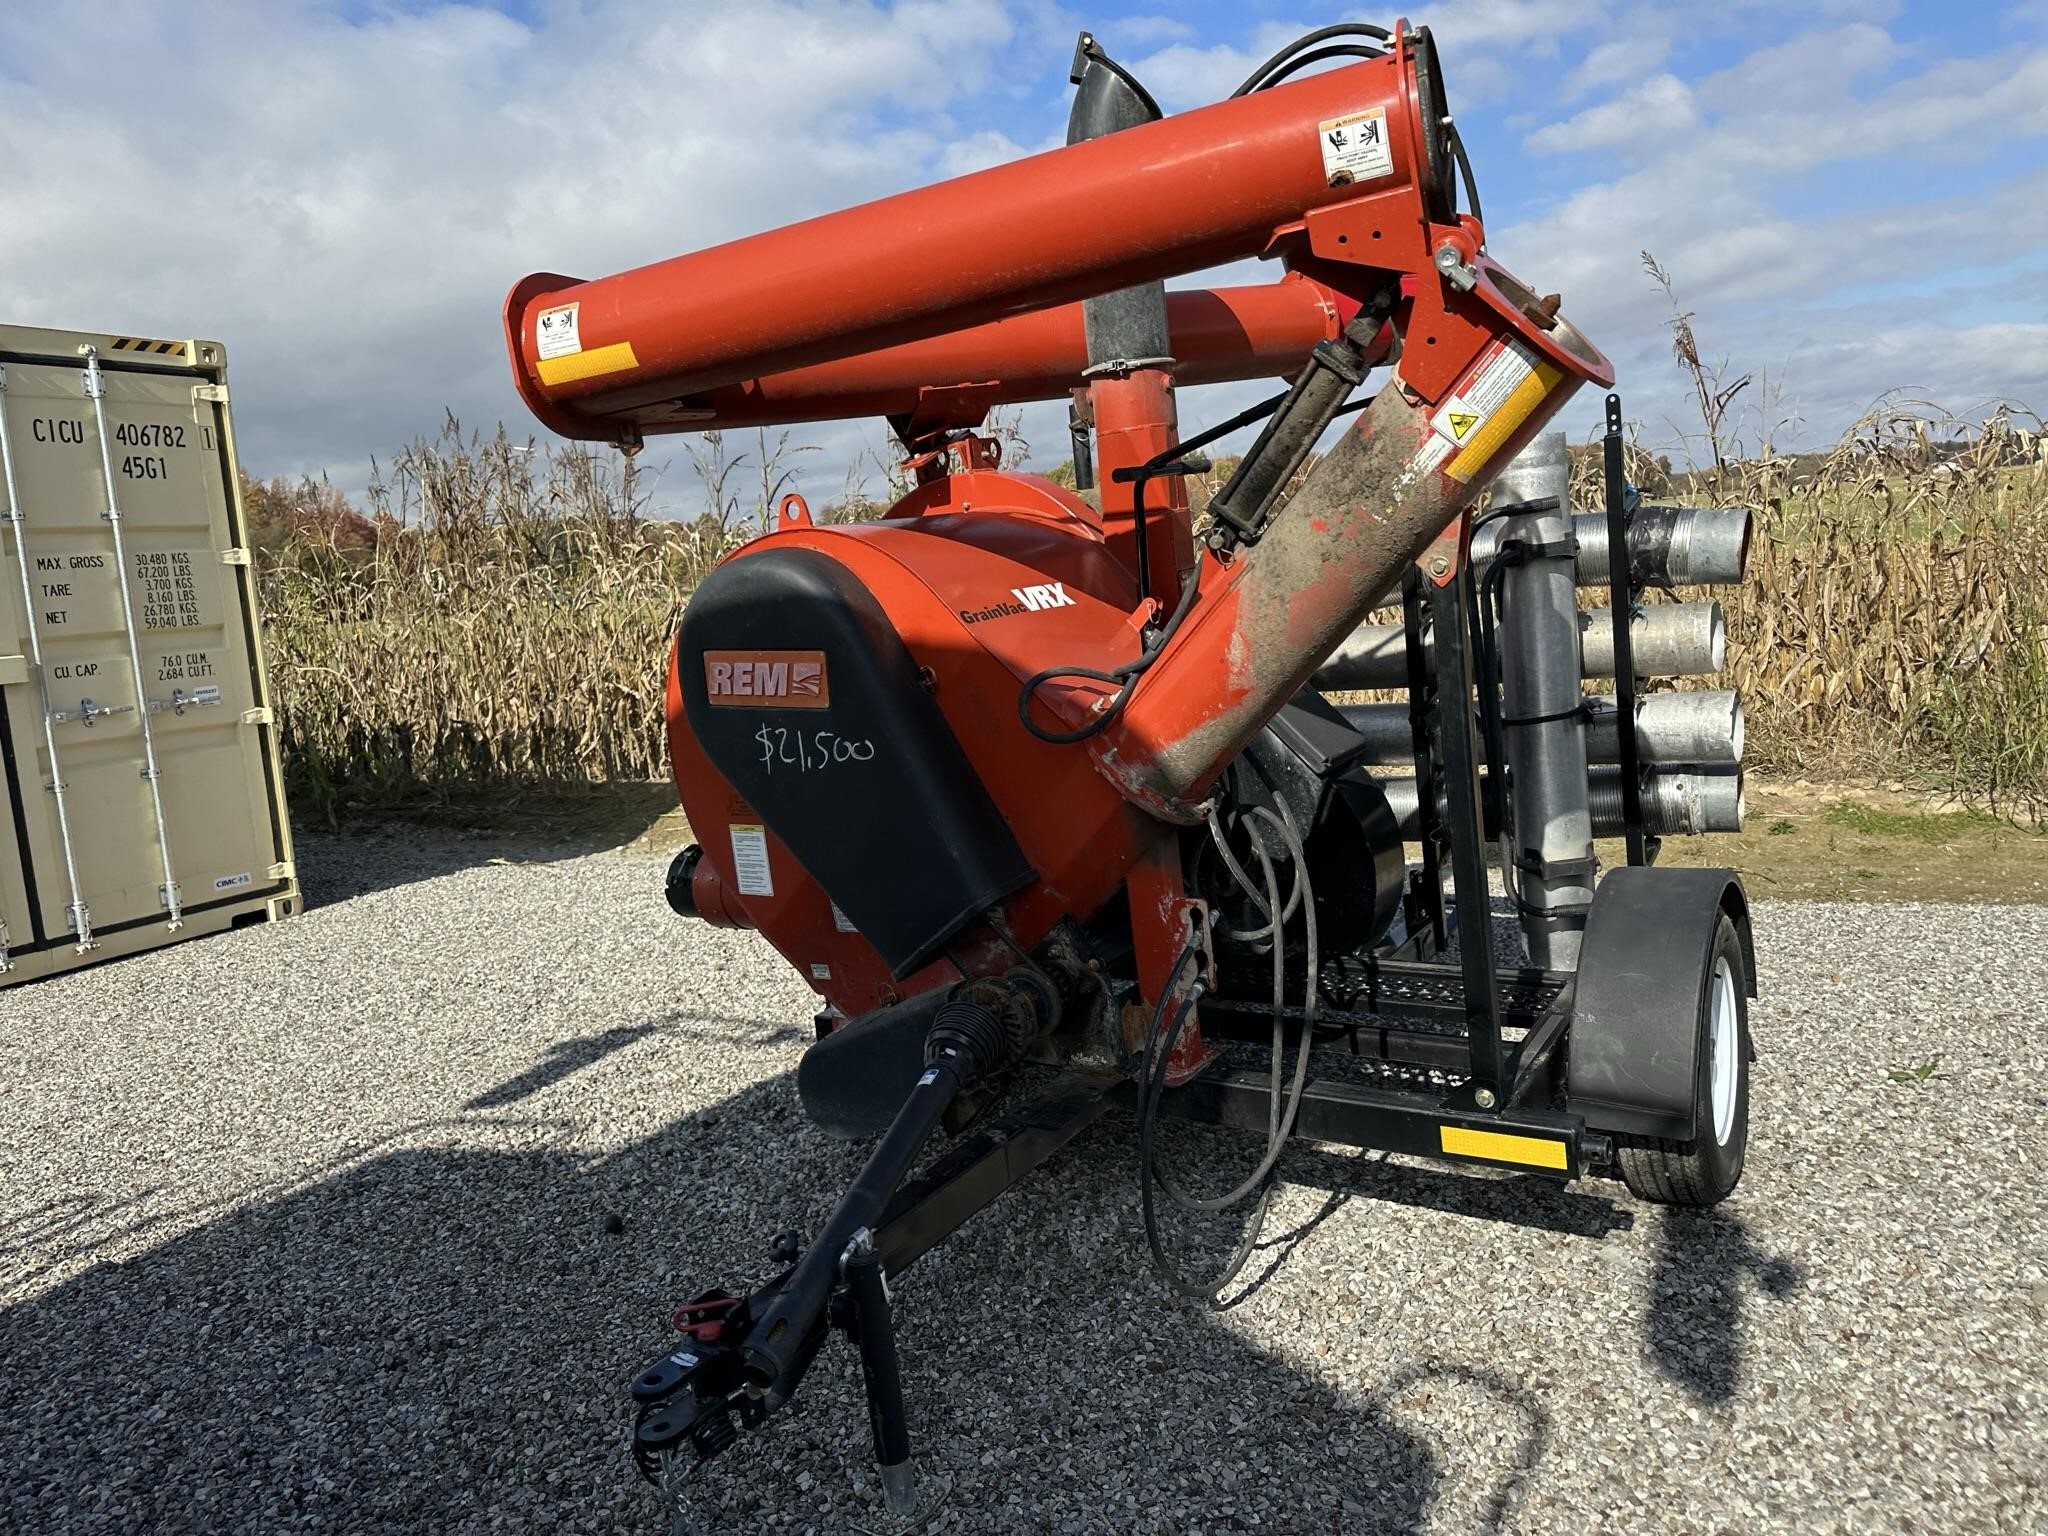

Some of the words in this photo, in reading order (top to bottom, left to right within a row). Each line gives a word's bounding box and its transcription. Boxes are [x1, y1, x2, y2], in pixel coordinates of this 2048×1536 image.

[1342, 114, 1370, 125] WARNING
[1476, 352, 1497, 375] DANGER
[116, 423, 187, 448] 406782
[122, 455, 168, 480] 45G1
[36, 557, 66, 571] MAX.
[69, 555, 105, 569] GROSS
[135, 553, 167, 566] 30.480
[171, 552, 192, 565] KGS.
[137, 566, 169, 579] 67.200
[173, 564, 194, 577] LBS.
[41, 583, 73, 597] TARE
[145, 578, 171, 591] 3.700
[175, 577, 196, 590] KGS.
[147, 591, 173, 604] 8.160
[177, 589, 198, 602] LBS.
[959, 601, 1028, 625] GrainVac
[1011, 582, 1077, 611] VRX
[45, 610, 68, 624] NET
[143, 603, 175, 617] 26.780
[179, 602, 200, 615] KGS.
[145, 616, 177, 630] 59.040
[181, 614, 202, 627] LBS.
[161, 655, 182, 668] 76.0
[54, 666, 72, 679] CU.
[75, 663, 102, 678] CAP.
[158, 666, 184, 681] 2.684
[709, 661, 789, 697] REM
[754, 721, 875, 776] $21,500
[216, 878, 238, 888] CIMC
